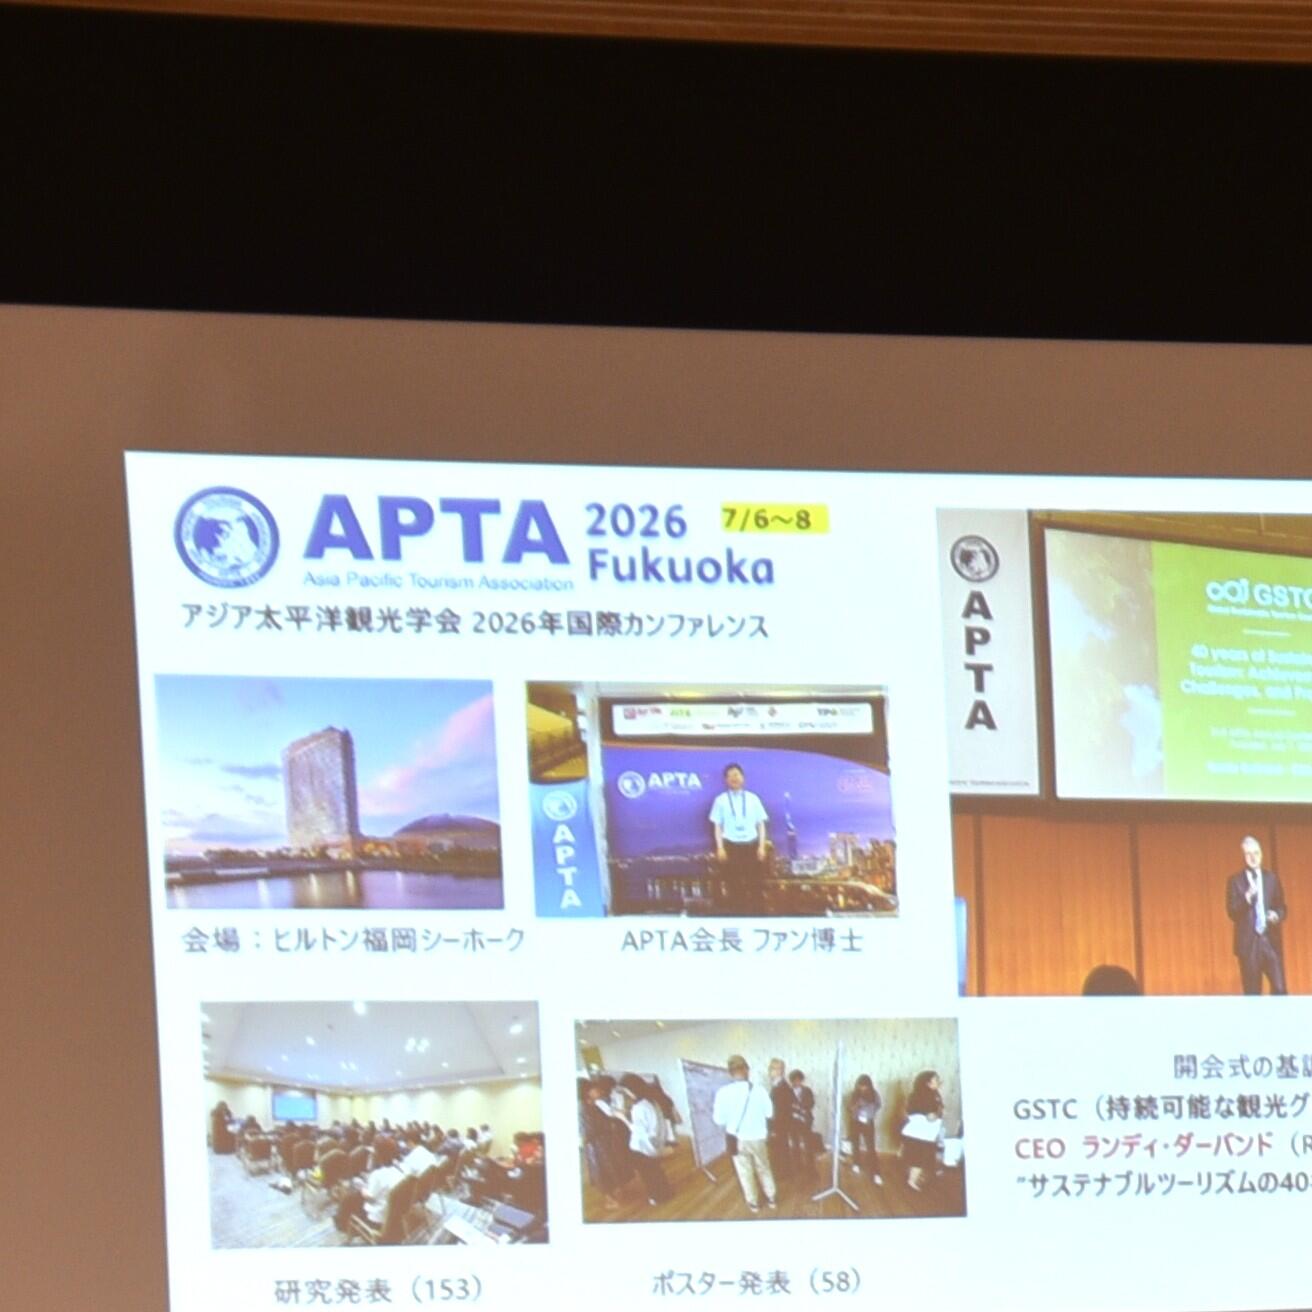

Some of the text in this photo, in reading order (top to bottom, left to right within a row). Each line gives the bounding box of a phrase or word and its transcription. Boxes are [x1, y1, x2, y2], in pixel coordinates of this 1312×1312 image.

[303, 493, 570, 566] APTA
[586, 503, 687, 539] 2026
[303, 571, 575, 592] Asia Pacific Tourism Association
[588, 548, 775, 585] Fukuoka
[182, 602, 769, 638] アジア太平洋観光学会 2026年国際カンファレンス
[961, 590, 998, 731] APTA
[648, 771, 702, 789] APTA
[553, 824, 582, 909] APTA
[621, 926, 863, 953] APTA会長 ファン博士
[1014, 1138, 1066, 1160] CEO
